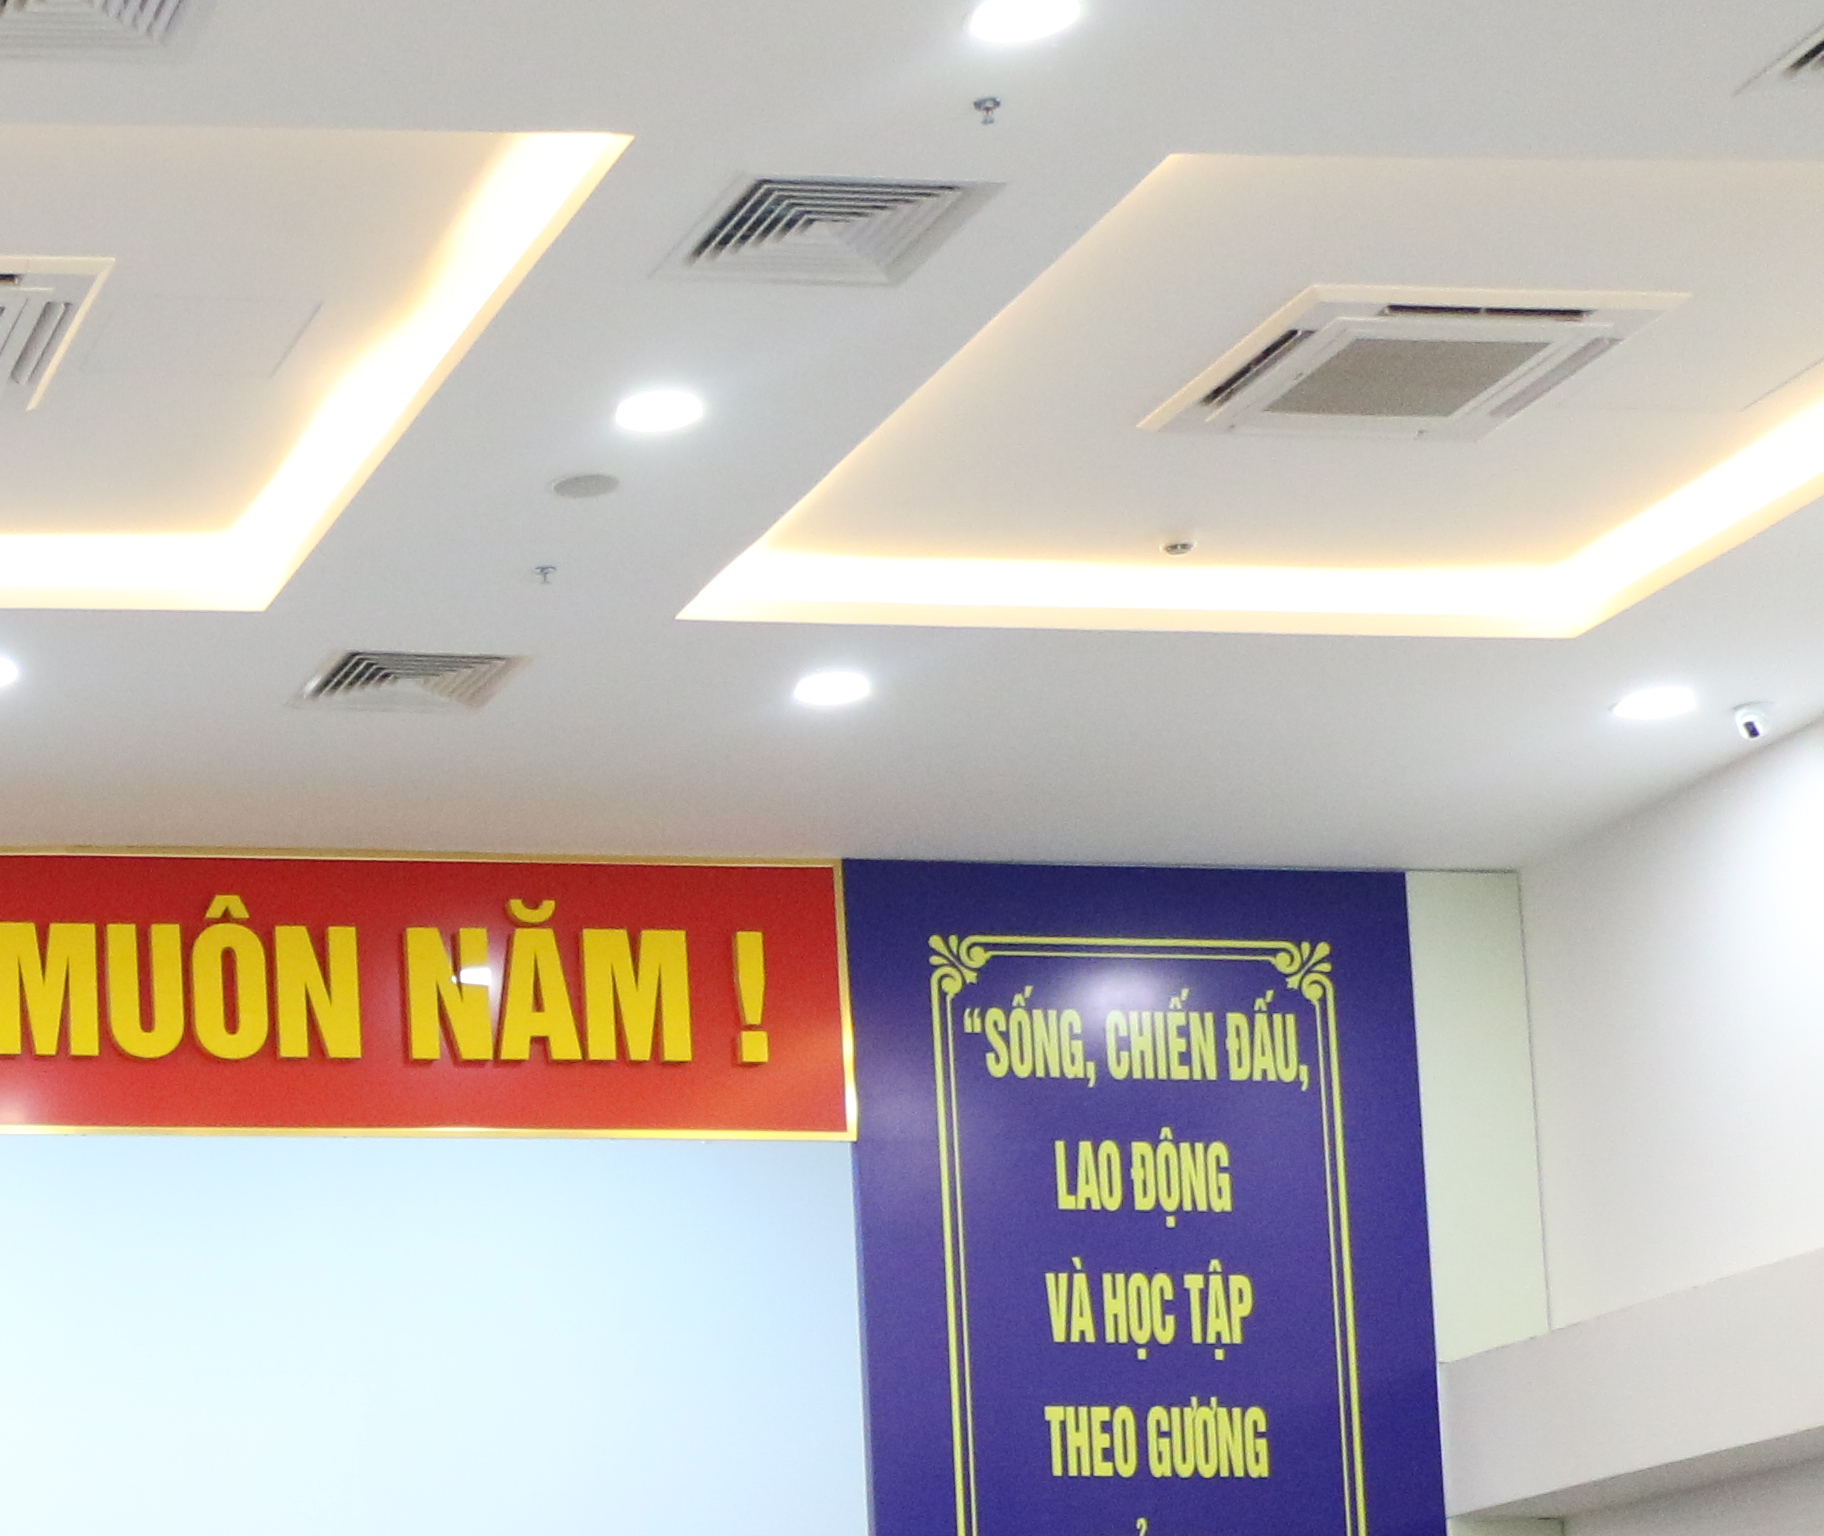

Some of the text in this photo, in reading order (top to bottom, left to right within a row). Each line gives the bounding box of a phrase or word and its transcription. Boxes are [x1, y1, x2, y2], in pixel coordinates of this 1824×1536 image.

[407, 900, 692, 1061] NĂM
[736, 931, 769, 1063] !
[965, 987, 1309, 1089] “SỐNG, CHIẾN ĐẤU,
[1055, 1127, 1232, 1227] LAO ĐỘNG
[1046, 1257, 1254, 1360] VÀ HỌC TẬP
[1045, 1397, 1270, 1478] THEO GƯƠNG
